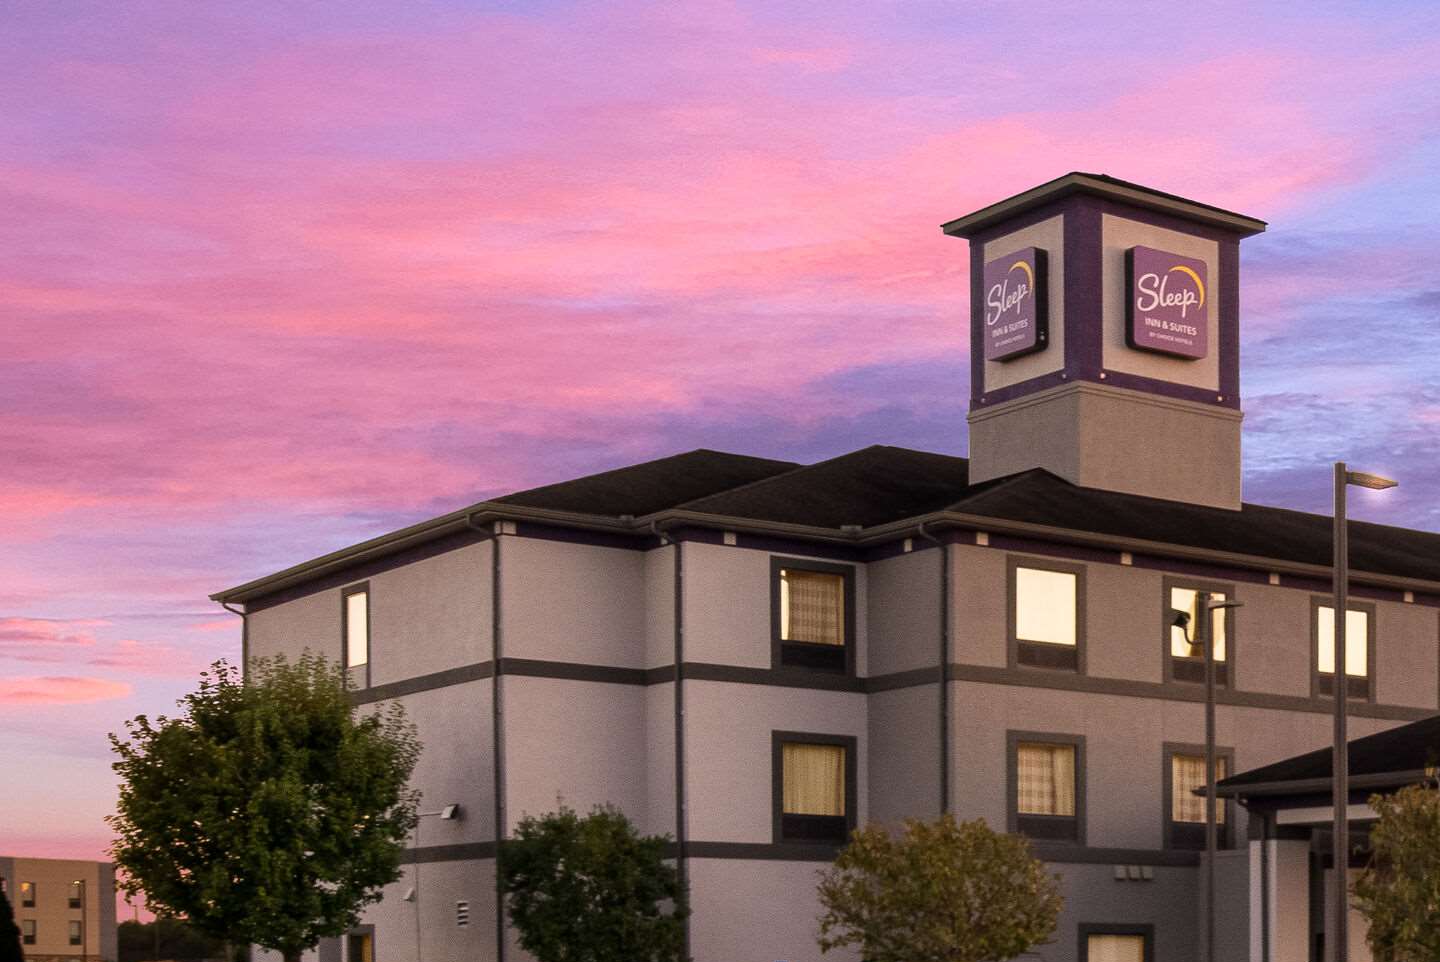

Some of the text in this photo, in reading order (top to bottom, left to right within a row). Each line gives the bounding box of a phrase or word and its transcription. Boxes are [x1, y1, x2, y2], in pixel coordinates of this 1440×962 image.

[987, 279, 1028, 325] Sleep
[1137, 273, 1198, 318] Sleep
[1009, 318, 1028, 332] SUITES
[1145, 317, 1197, 336] INN & SUITES
